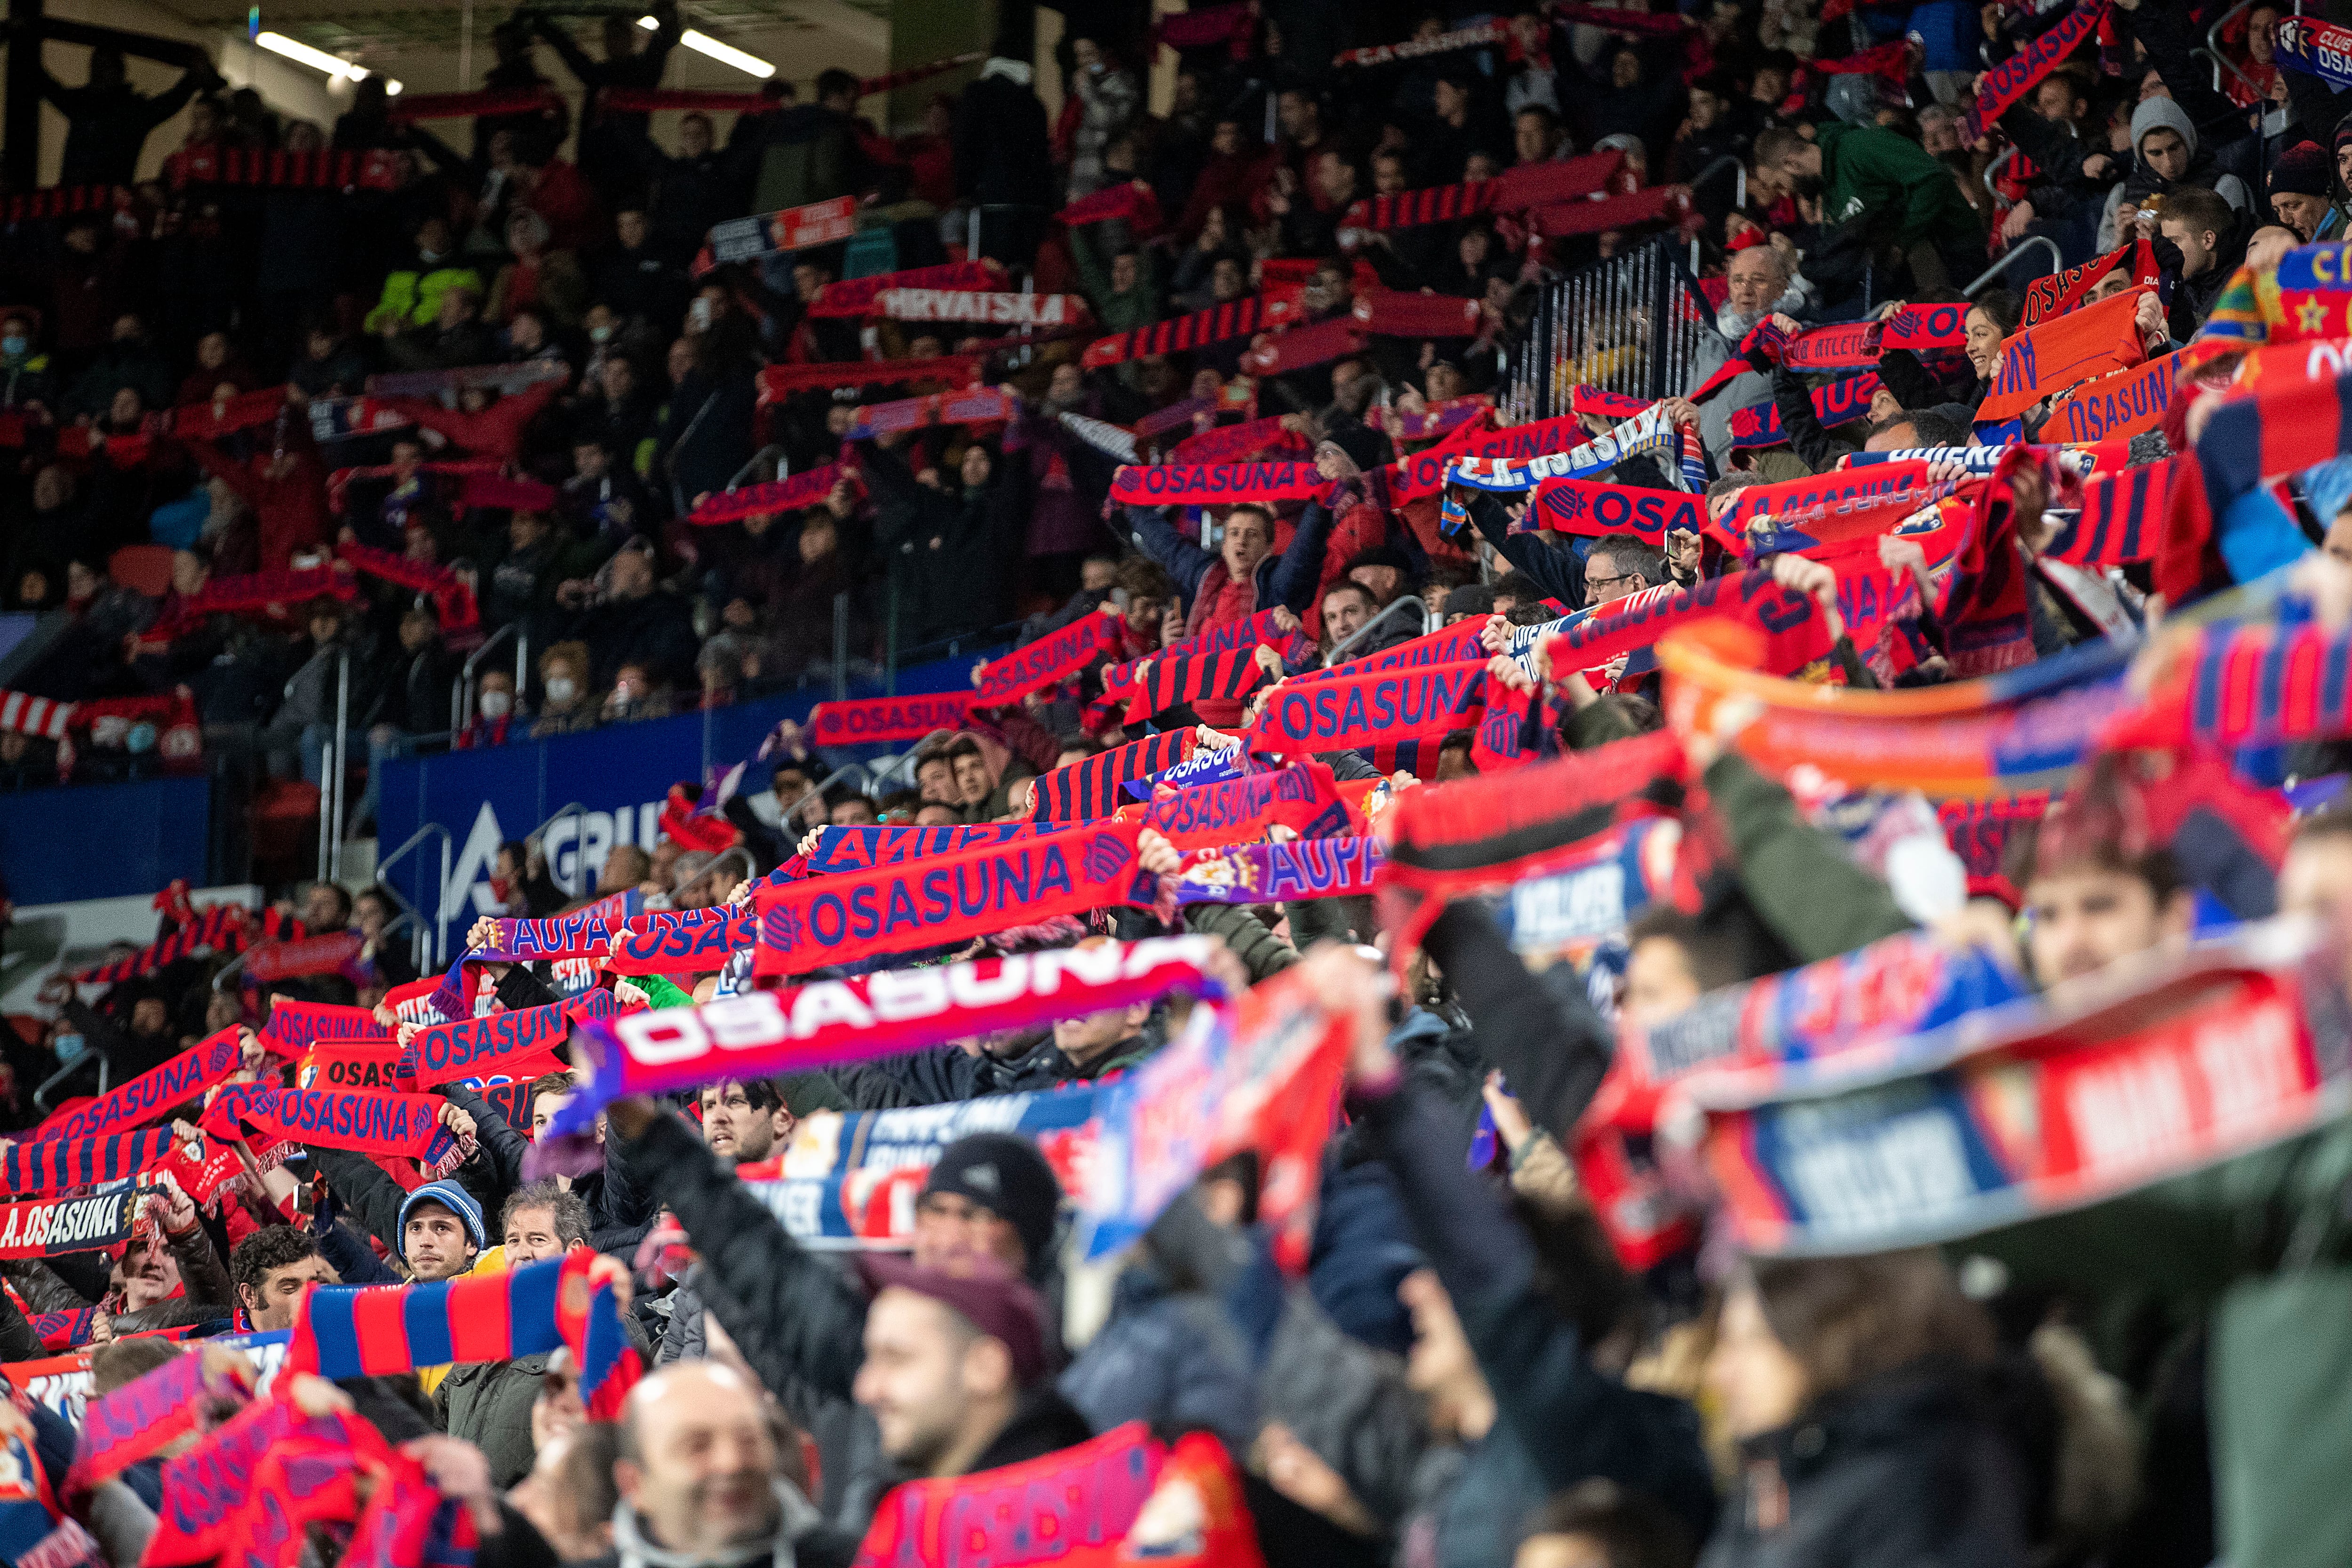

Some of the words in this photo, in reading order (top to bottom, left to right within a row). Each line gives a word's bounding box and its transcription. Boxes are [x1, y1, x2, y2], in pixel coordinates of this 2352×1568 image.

[1994, 5, 2099, 95] OSASUN
[2319, 31, 2352, 52] CLUB
[1146, 462, 1295, 493] OSASUNA
[976, 625, 1094, 699] OSASUNA
[850, 700, 966, 733] OSASUN
[1282, 669, 1487, 740] OSASUNA
[810, 844, 1071, 947] OSASUNA
[513, 918, 611, 955] AUPA
[280, 1011, 363, 1047] OSASUNA
[616, 936, 1208, 1065] OSASUNA
[63, 1054, 203, 1140] OSASUNA
[282, 1090, 408, 1142] OSASUNA
